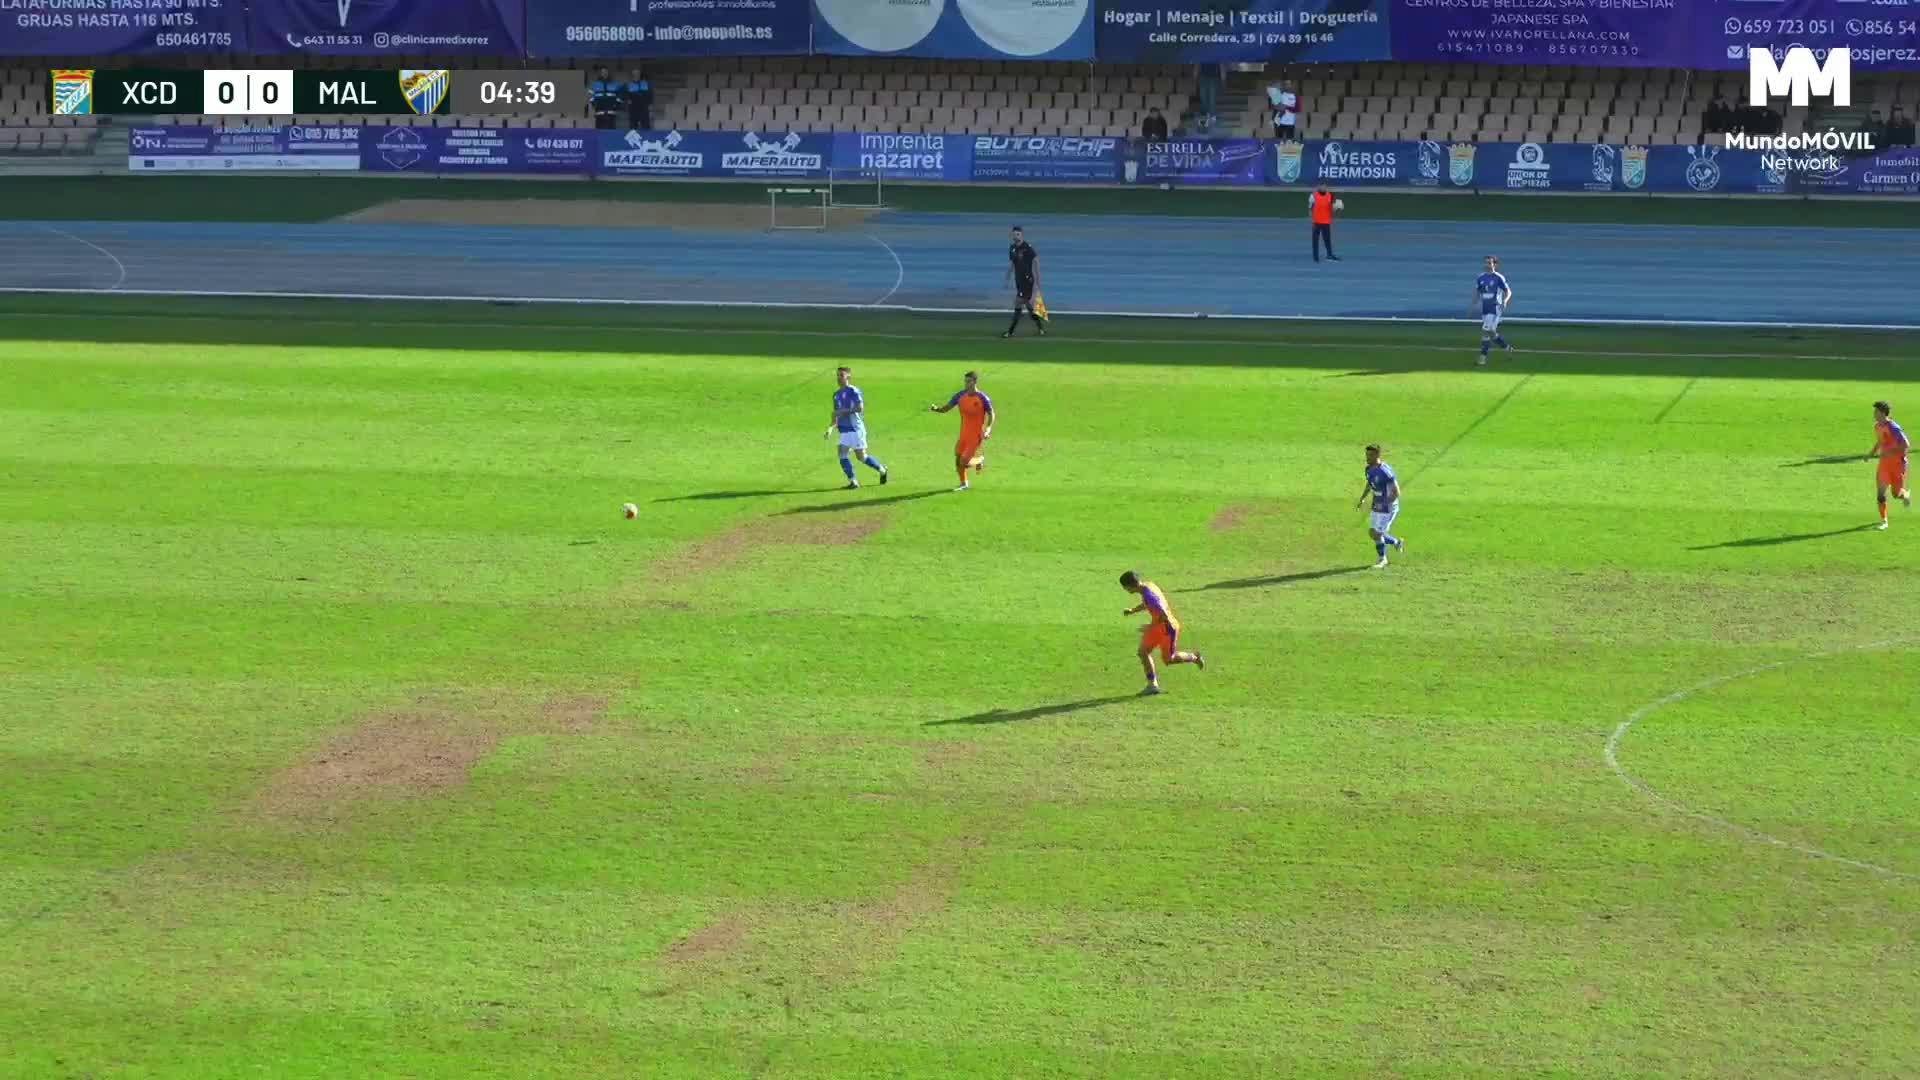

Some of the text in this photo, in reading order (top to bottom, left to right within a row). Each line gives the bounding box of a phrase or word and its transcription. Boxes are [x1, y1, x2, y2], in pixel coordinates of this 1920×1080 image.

[111, 0, 162, 9] HASTA
[1471, 0, 1489, 8] DE
[1599, 0, 1674, 9] BIENESTAR
[17, 13, 198, 27] GRUAS HASTA 116 MTS.
[1104, 11, 1151, 26] Hogar
[1167, 11, 1224, 27] Menaje
[1240, 11, 1284, 24] Textil
[1299, 10, 1378, 26] Droguería
[1491, 14, 1588, 25] JAPANESE SPA
[566, 26, 644, 41] 956058890
[654, 25, 773, 41] info@neopolis.es
[1743, 20, 1917, 34] 659 723 051 856 54
[156, 33, 231, 46] 650461785
[304, 35, 324, 45] 643
[326, 35, 335, 45] 11
[352, 35, 363, 45] 31
[390, 33, 489, 46] @clinicamedixerez
[1149, 32, 1177, 43] Calle
[1180, 32, 1240, 44] Corredera,
[1266, 33, 1286, 43] 674
[861, 133, 944, 151] imprenta
[1147, 143, 1215, 154] ESTRELLA
[608, 154, 698, 166] MAFERAUTO
[727, 155, 817, 167] MAFERAUTO
[861, 152, 944, 169] nazaret
[1146, 154, 1213, 168] DE VIDA
[1318, 152, 1396, 166] VIVEROS
[1863, 171, 1908, 184] Carmen
